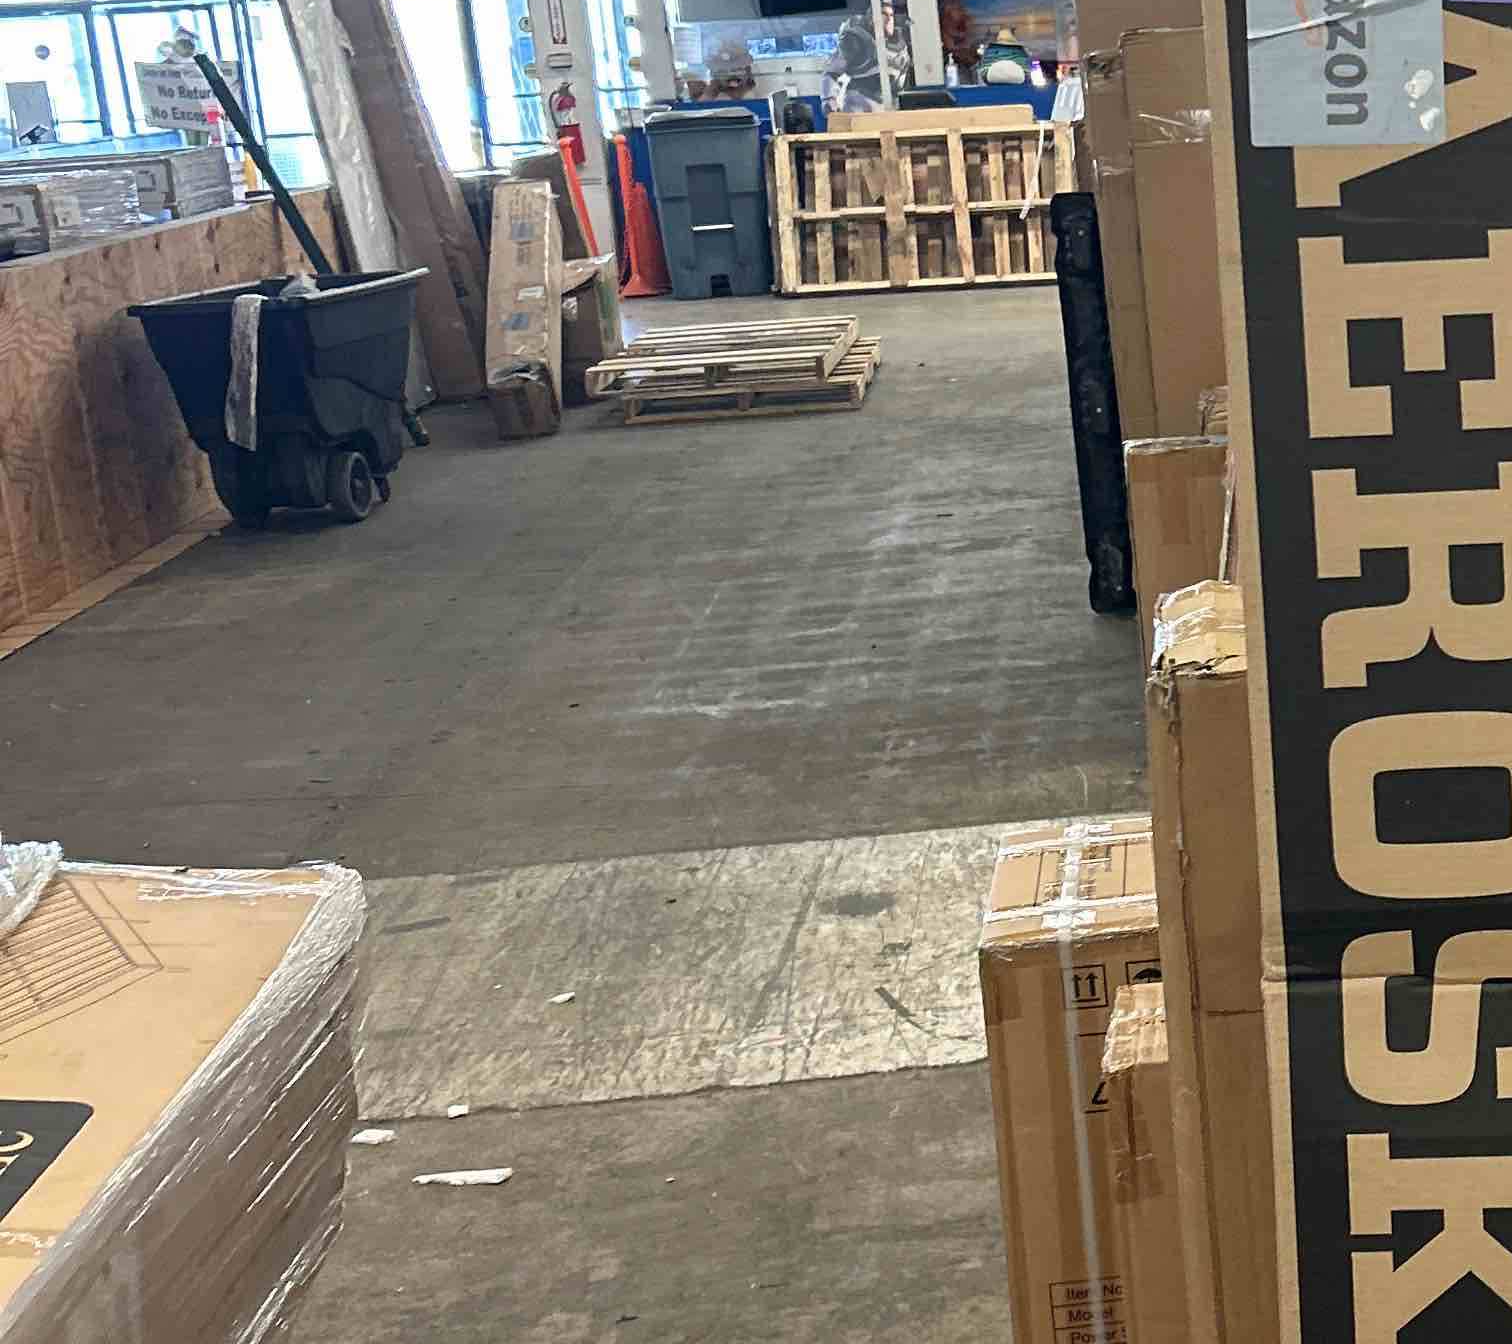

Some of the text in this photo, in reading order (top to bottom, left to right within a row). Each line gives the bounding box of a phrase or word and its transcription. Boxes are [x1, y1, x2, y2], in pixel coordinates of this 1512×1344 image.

[158, 85, 212, 99] No Retur
[150, 106, 169, 119] No
[1065, 1287, 1094, 1300] Ite
[1067, 1307, 1113, 1323] Moel
